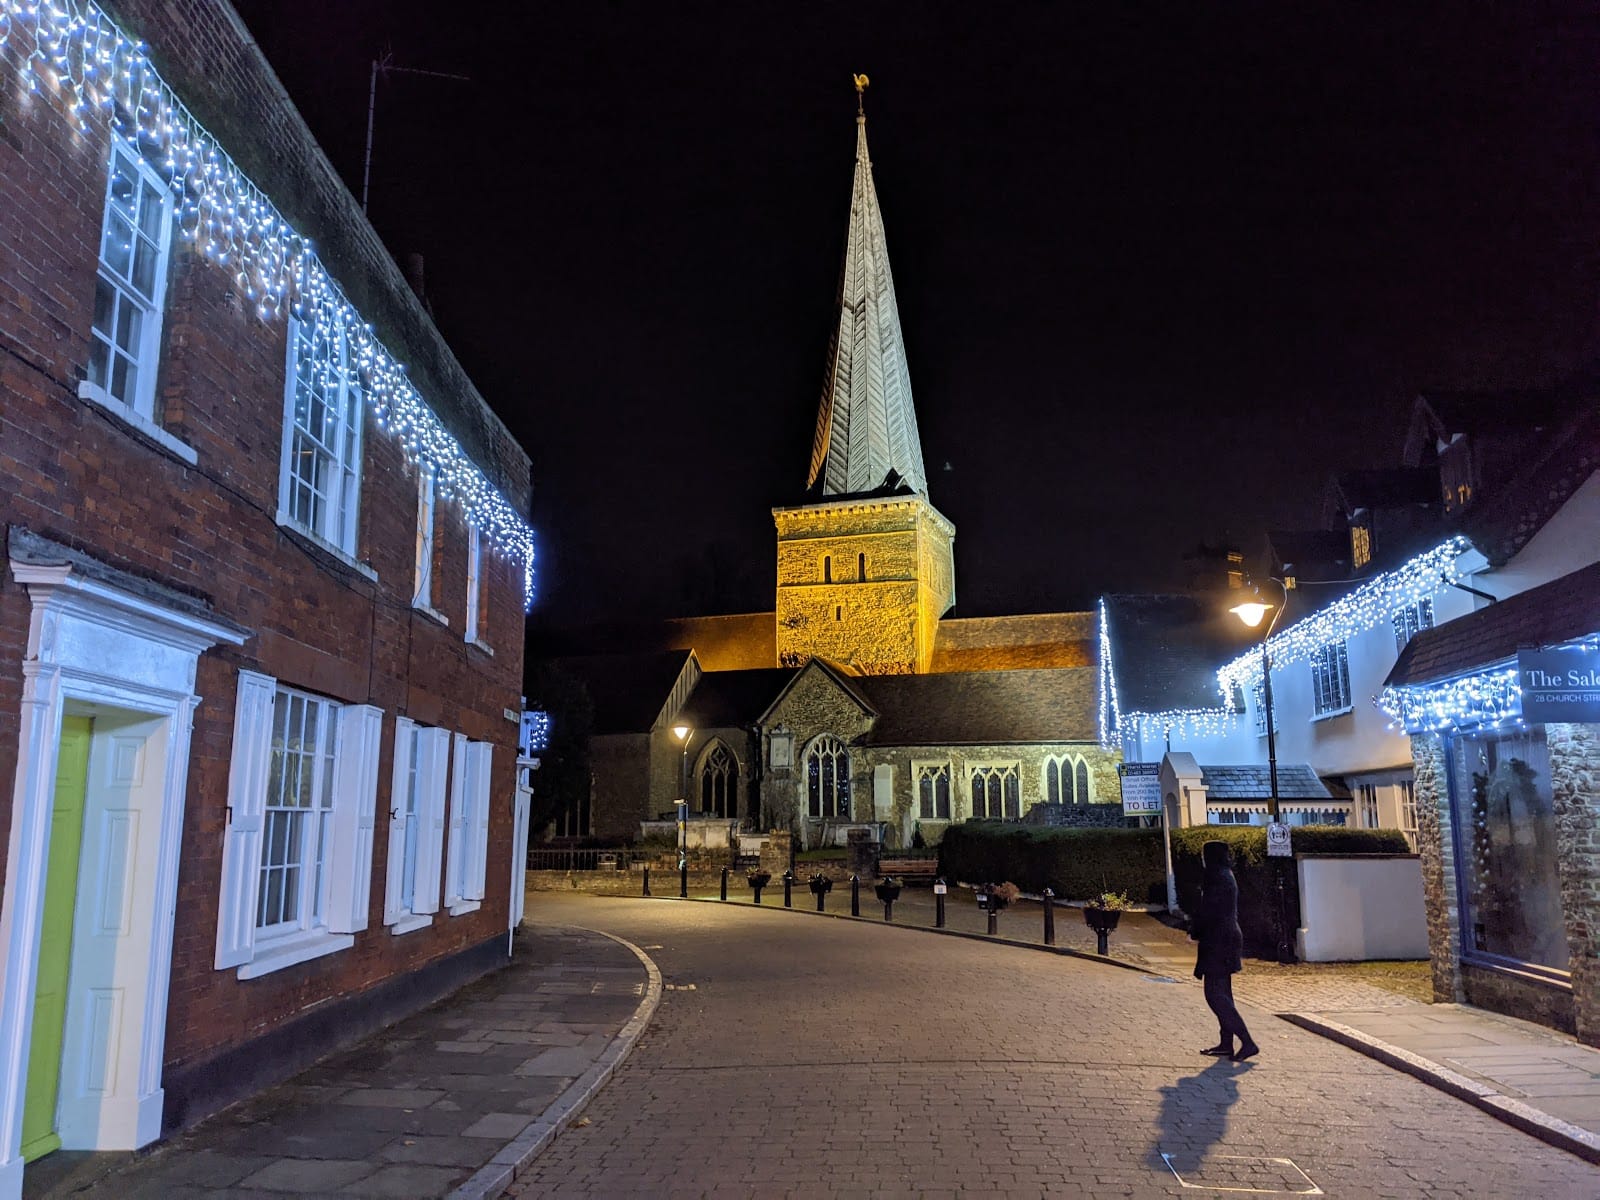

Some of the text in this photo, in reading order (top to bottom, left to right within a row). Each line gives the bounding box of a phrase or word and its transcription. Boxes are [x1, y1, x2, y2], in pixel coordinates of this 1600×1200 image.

[1526, 670, 1562, 687] The
[1536, 694, 1545, 702] 28
[1546, 694, 1581, 702] CHURCH
[1126, 801, 1160, 810] TO LET
